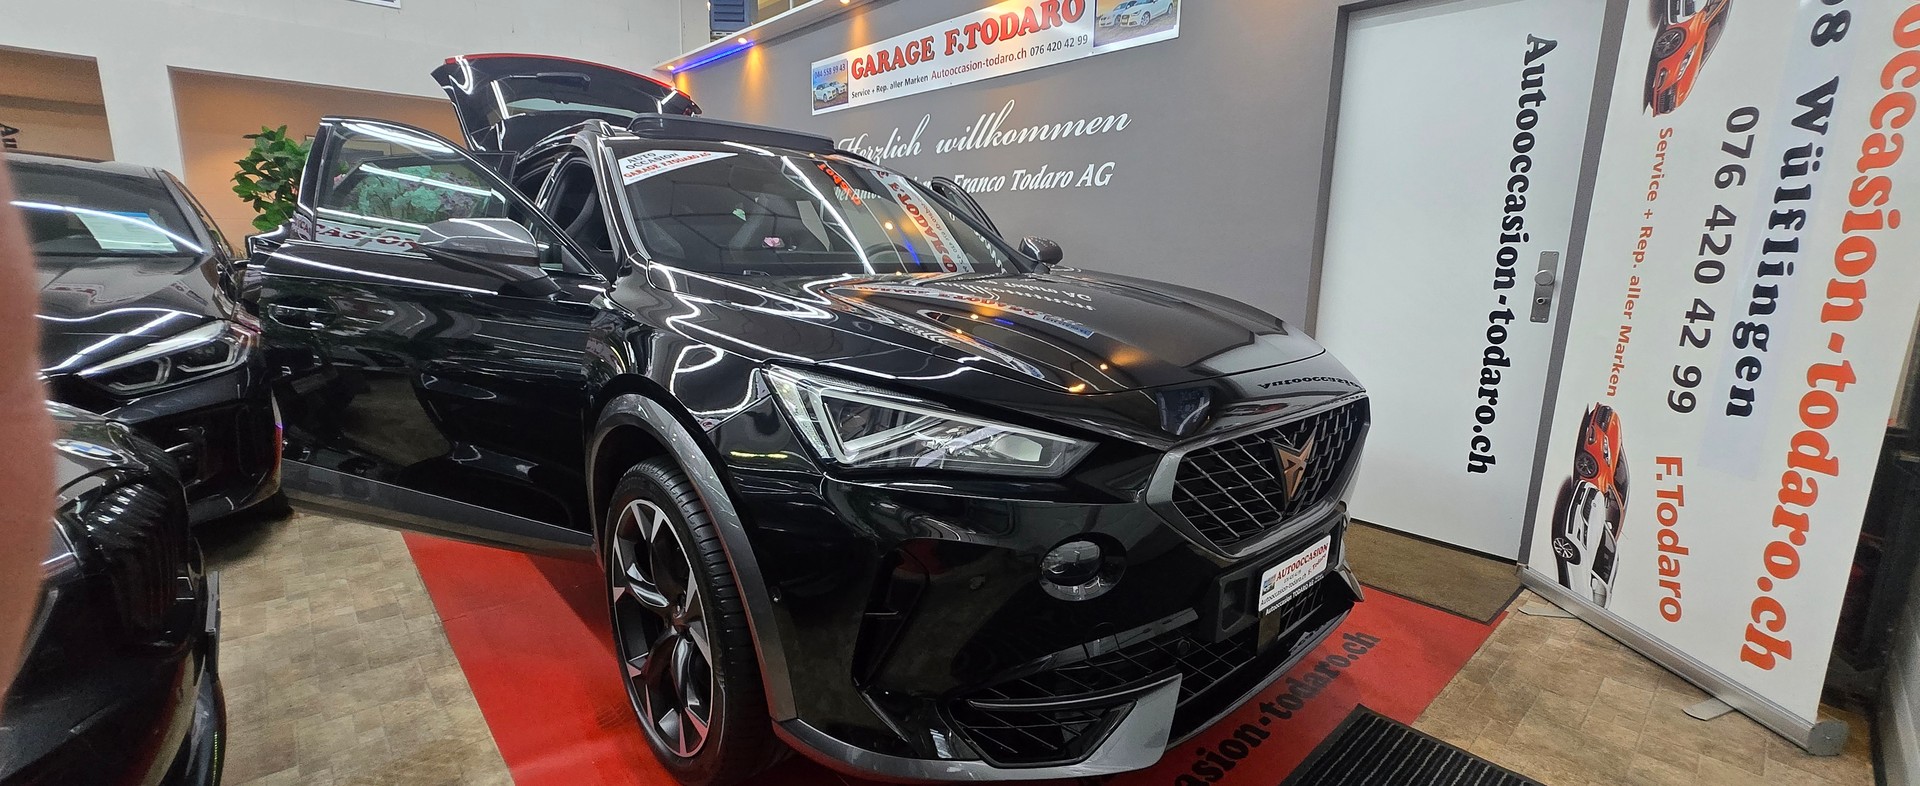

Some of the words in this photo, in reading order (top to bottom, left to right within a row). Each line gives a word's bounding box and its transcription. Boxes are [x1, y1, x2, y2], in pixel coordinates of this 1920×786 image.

[851, 36, 935, 80] GARAGE
[944, 0, 1086, 56] F.TODARO
[1810, 0, 1851, 47] 8
[851, 87, 871, 99] Service
[876, 83, 889, 94] Rep.
[889, 80, 903, 90] aller
[904, 74, 929, 87] Marken
[930, 47, 1027, 80] Autooccasion-todaro.ch
[1029, 45, 1044, 57] 076
[1046, 41, 1062, 53] 420
[1064, 37, 1075, 48] 42
[1077, 34, 1088, 45] 99
[838, 113, 931, 164] Herzlich
[935, 99, 1132, 154] willkommen
[1715, 106, 1760, 189] 076
[623, 164, 661, 178] GARAGE
[626, 152, 656, 164] AUTO
[626, 152, 680, 169] OCCASION
[953, 174, 1006, 194] Franco
[1010, 164, 1074, 191] Todaro
[1074, 161, 1116, 188] AG
[1646, 126, 1673, 203] Service
[1643, 208, 1653, 219] +
[1467, 33, 1559, 474] Autooccasion-todaro.ch
[1631, 225, 1654, 269] Rep.
[1693, 204, 1737, 284] 420
[1726, 75, 1839, 418] Wülflingen
[1623, 275, 1641, 320] aller
[1679, 298, 1716, 349] 42
[1606, 326, 1632, 397] Marken
[1667, 364, 1702, 414] 99
[1276, 543, 1329, 581] AUTOOCCASION
[1655, 456, 1689, 623] F.Todaro
